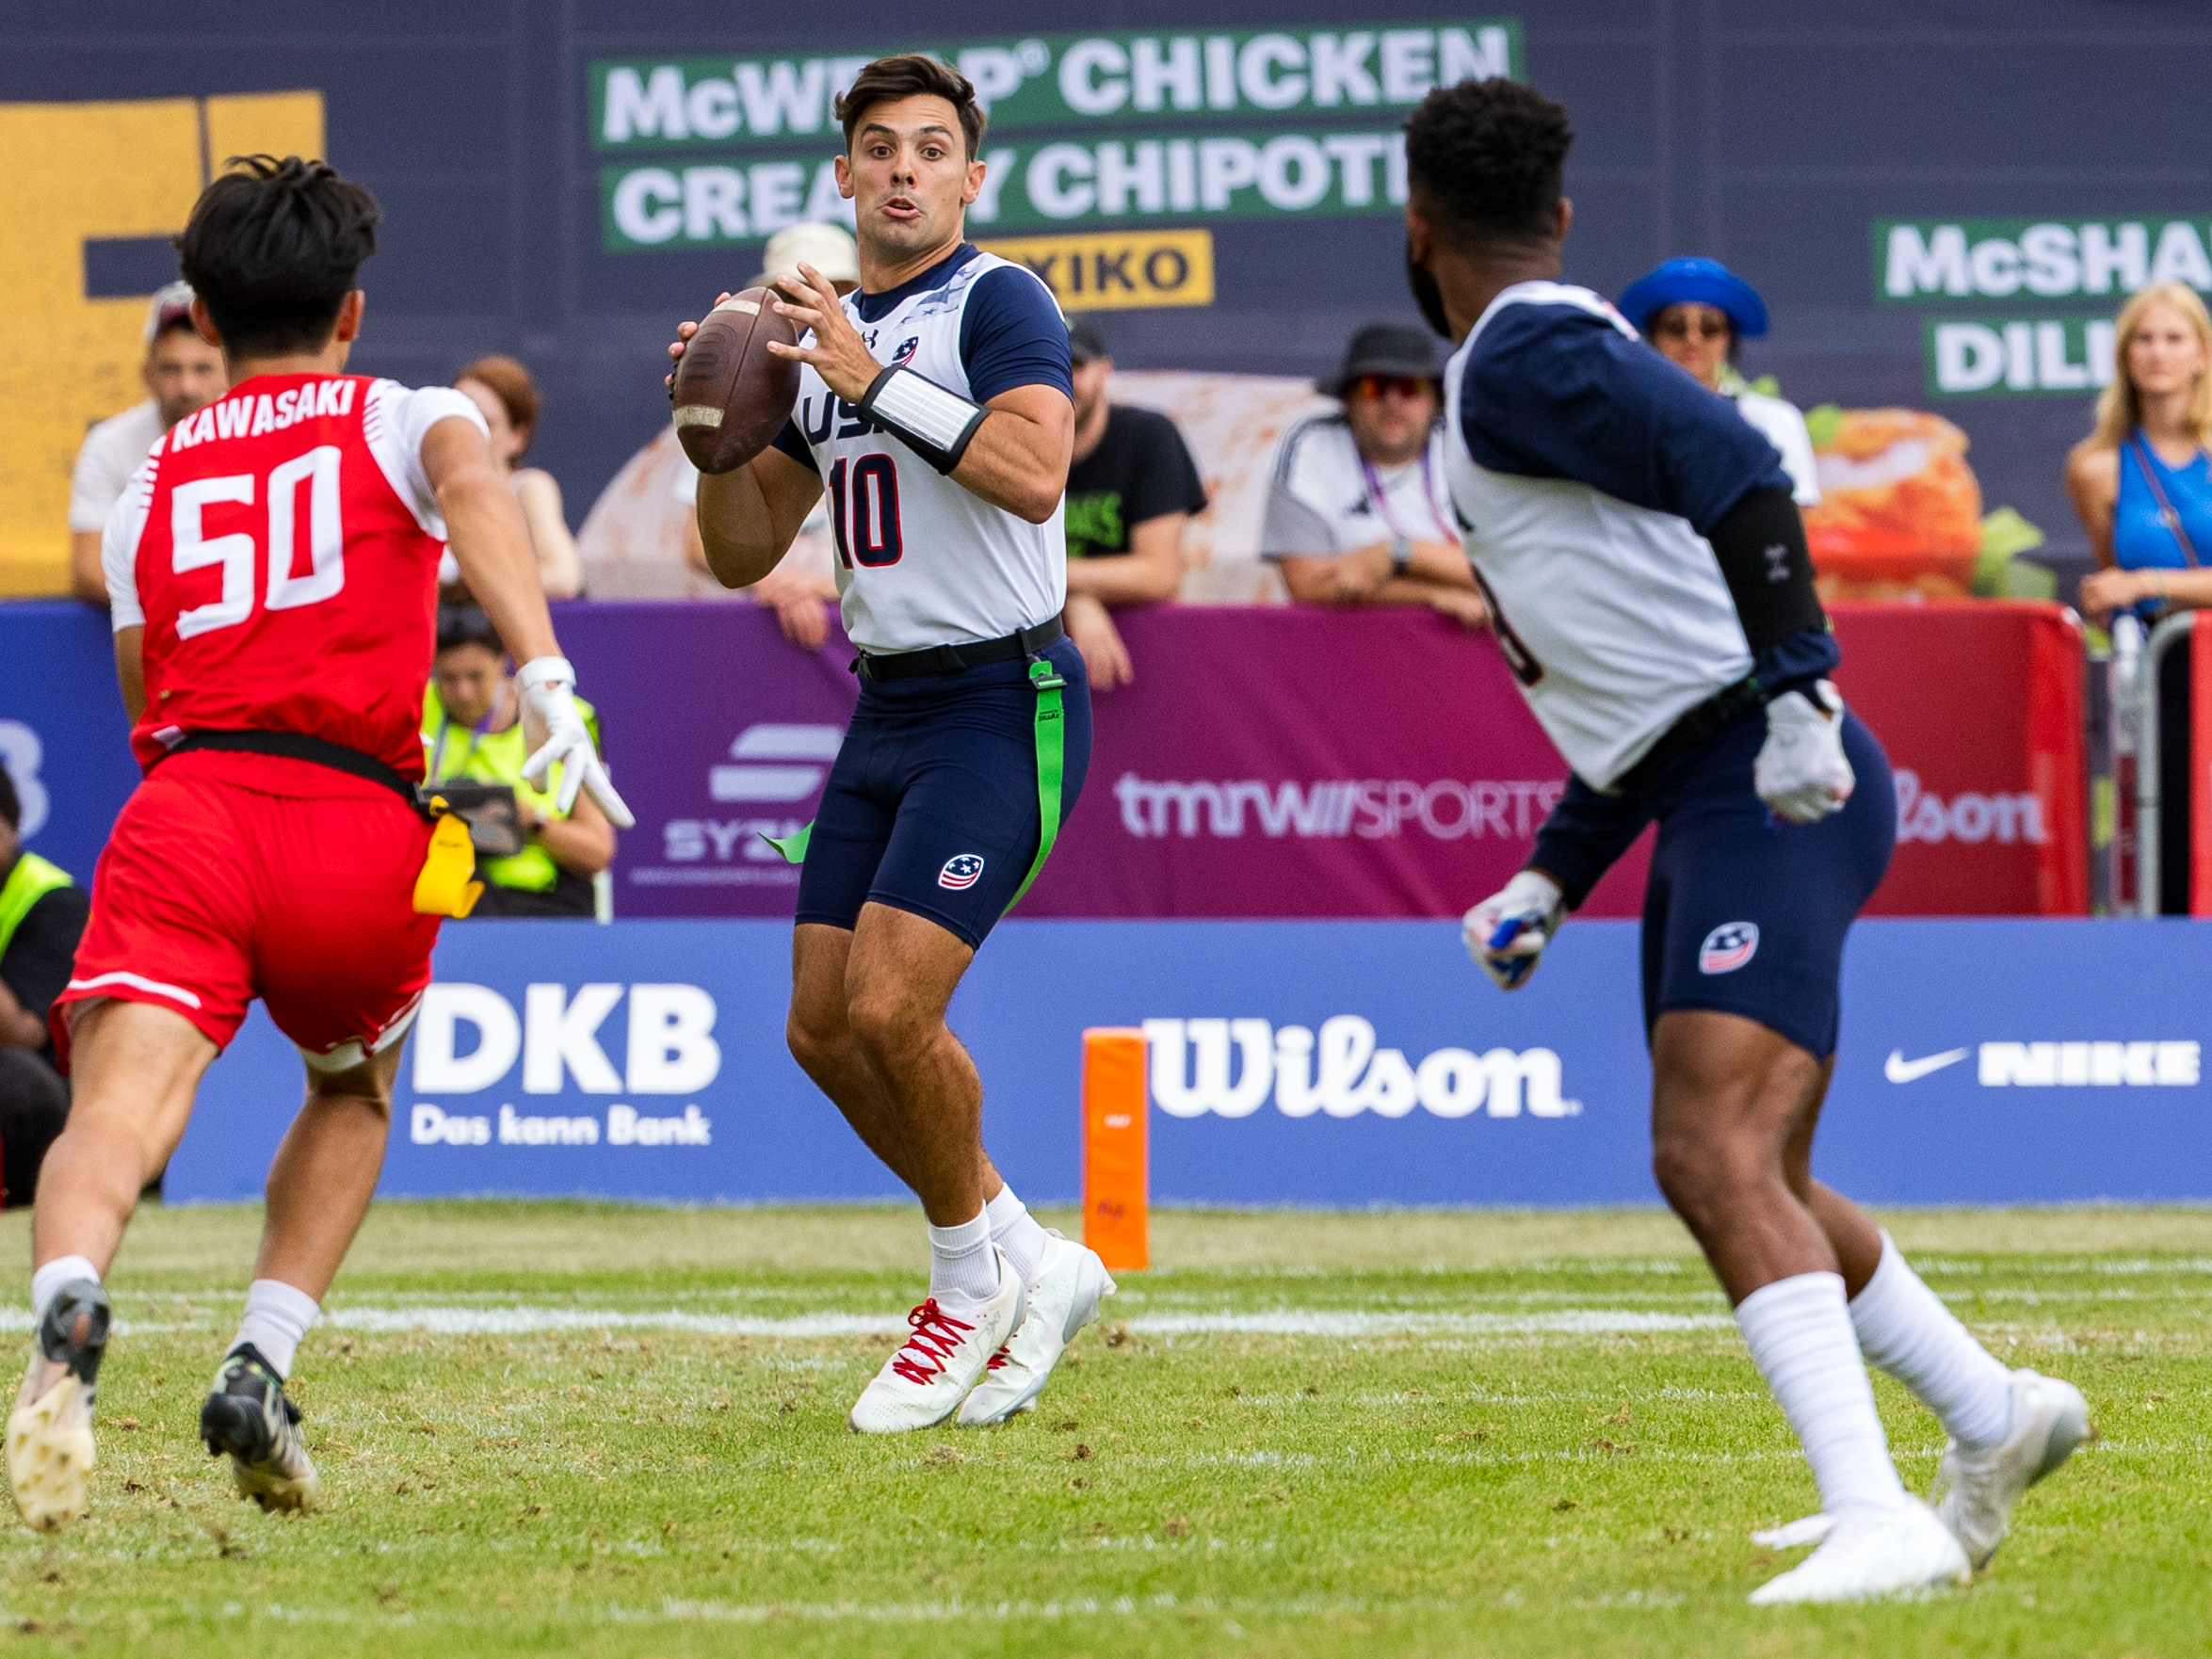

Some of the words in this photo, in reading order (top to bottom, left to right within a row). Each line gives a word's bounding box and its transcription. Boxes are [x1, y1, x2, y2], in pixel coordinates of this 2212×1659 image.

[1058, 25, 1510, 116] CHICKEN
[612, 148, 1017, 244] CREAY
[1885, 220, 2212, 298] McSHA
[171, 379, 356, 453] KAWASAKI
[803, 392, 885, 446] US
[171, 446, 345, 640] 50
[829, 453, 904, 570] 10
[412, 983, 722, 1094] DKB
[1978, 1040, 2201, 1087] NIKE
[412, 1103, 491, 1145] Das
[499, 1103, 599, 1145] kann
[607, 1103, 711, 1145] Bank
